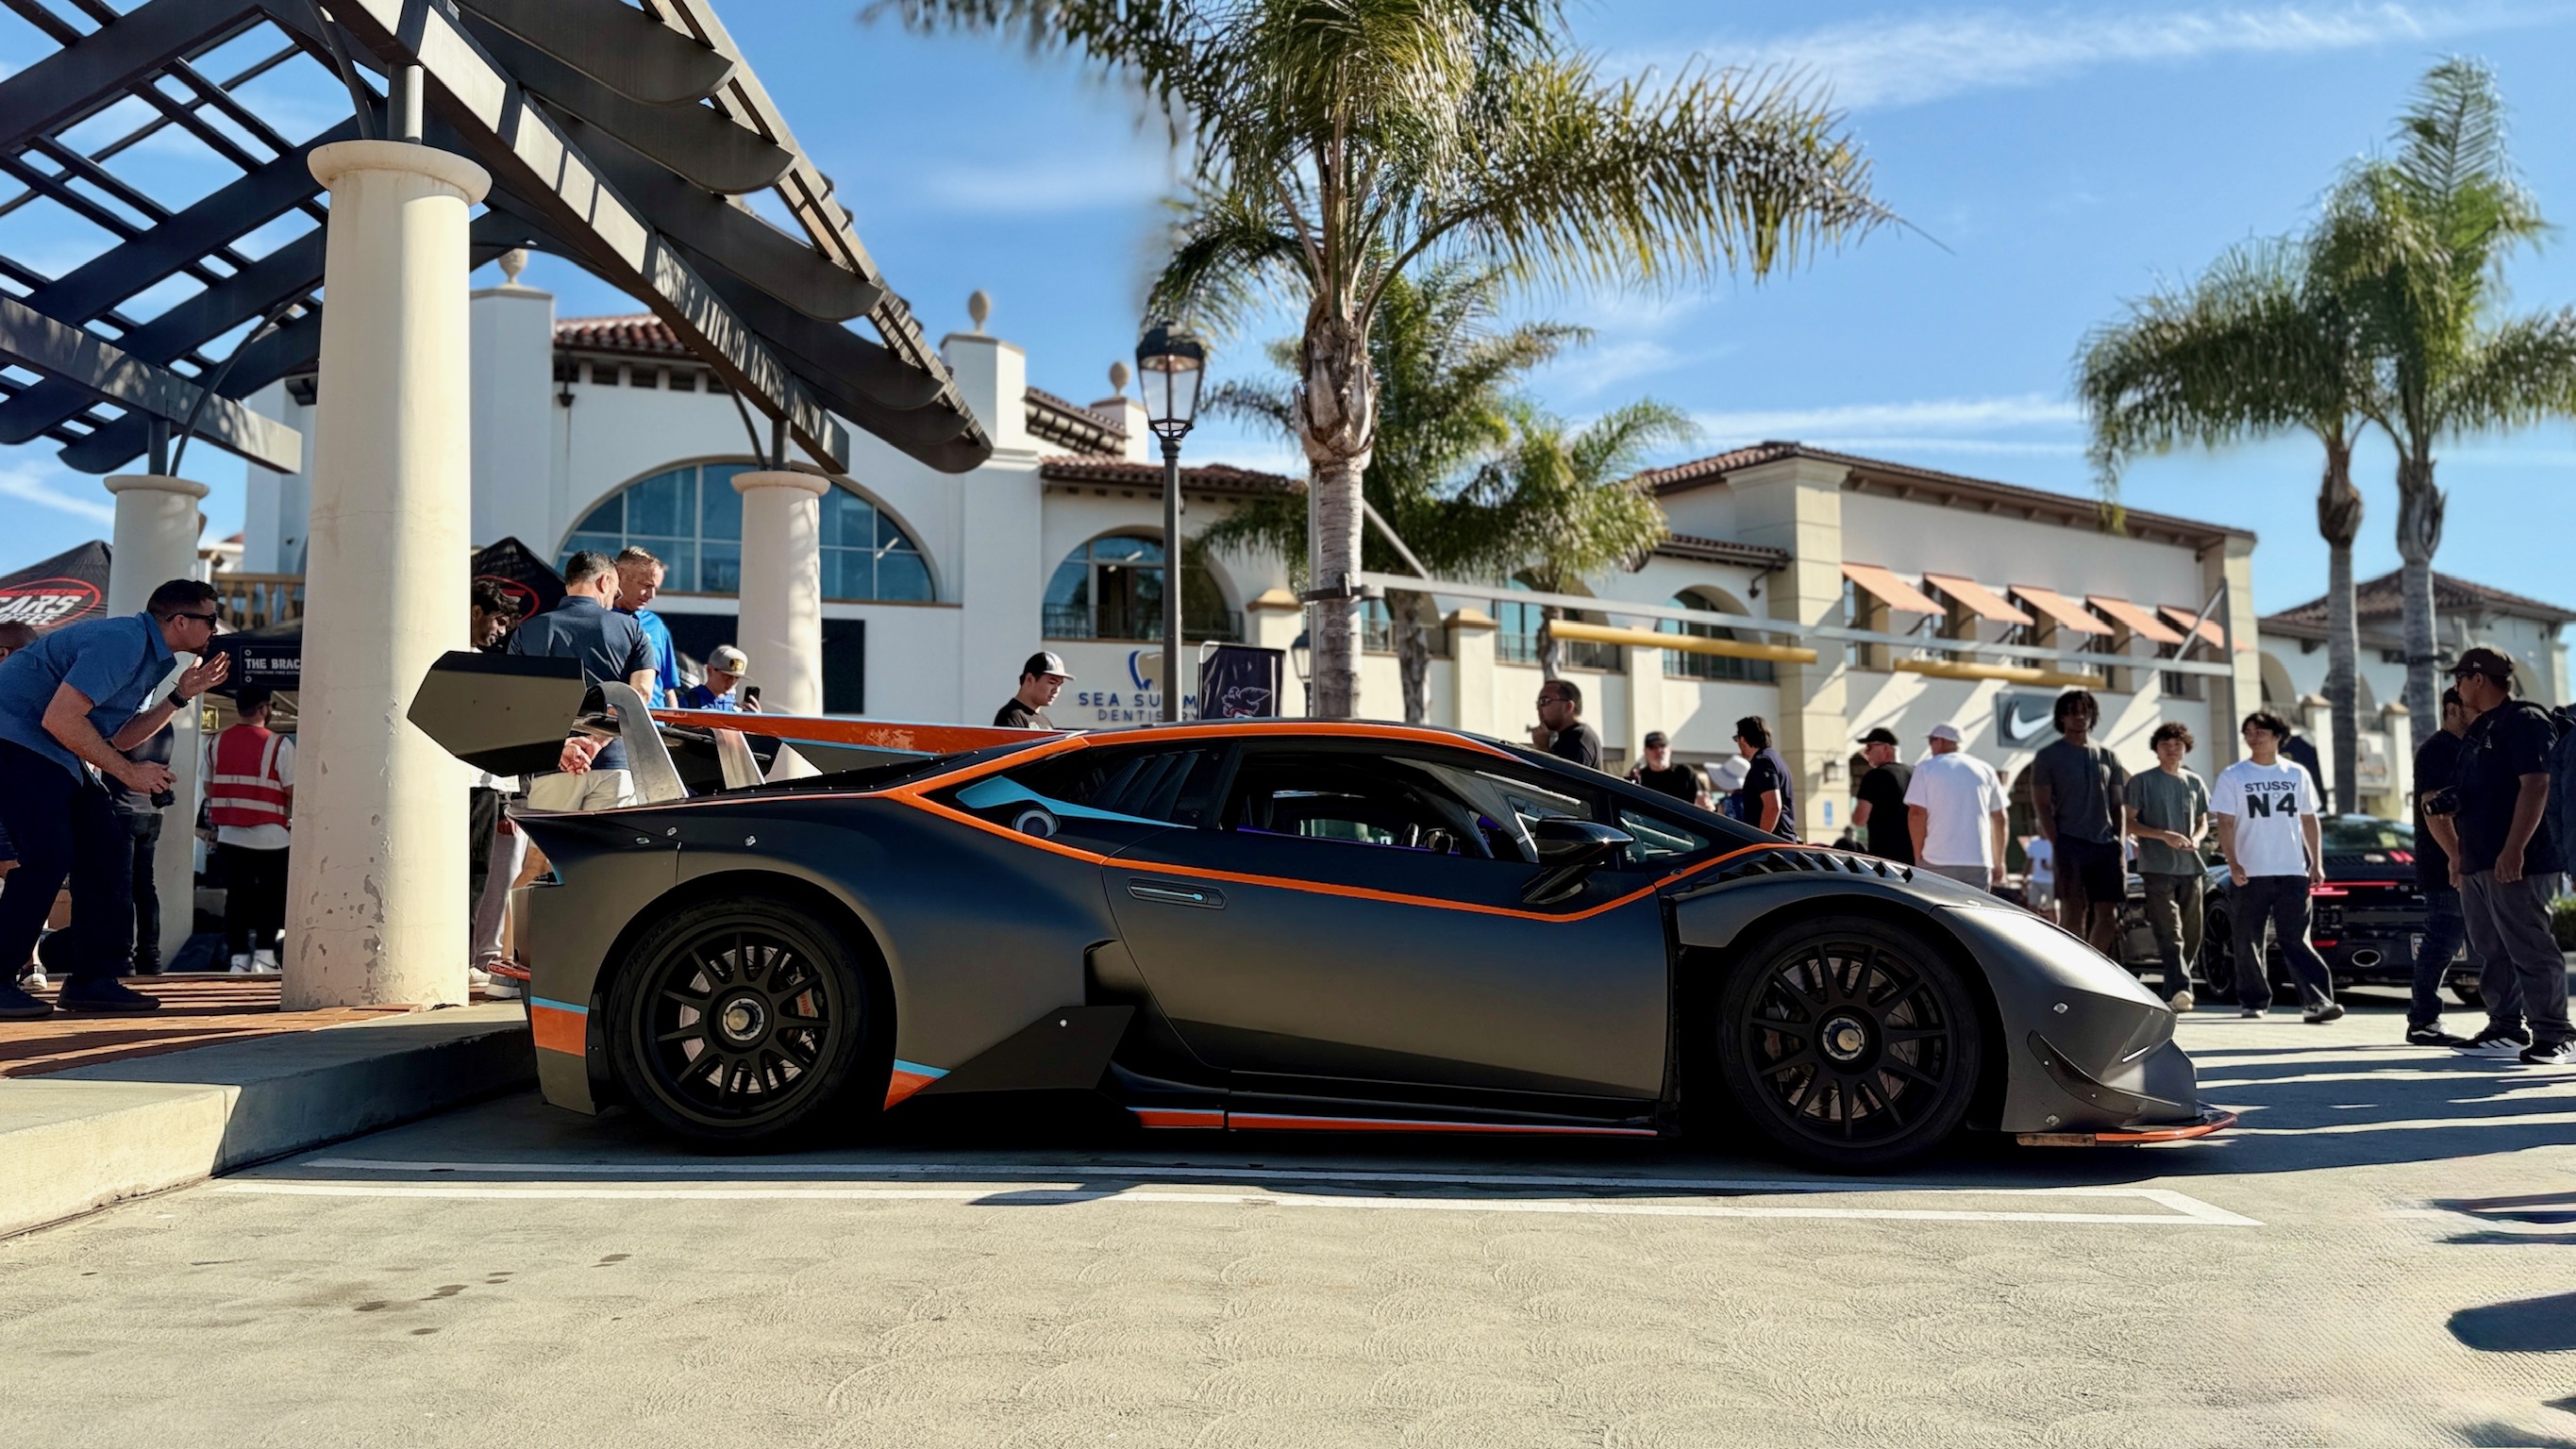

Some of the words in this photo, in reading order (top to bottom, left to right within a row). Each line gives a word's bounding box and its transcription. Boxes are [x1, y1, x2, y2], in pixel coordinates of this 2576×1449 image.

[244, 658, 267, 670] THE
[1079, 692, 1120, 707] SEA
[1134, 693, 1197, 708] SUM
[1098, 709, 1197, 722] DENTISRY
[2244, 781, 2298, 793] STUSSY
